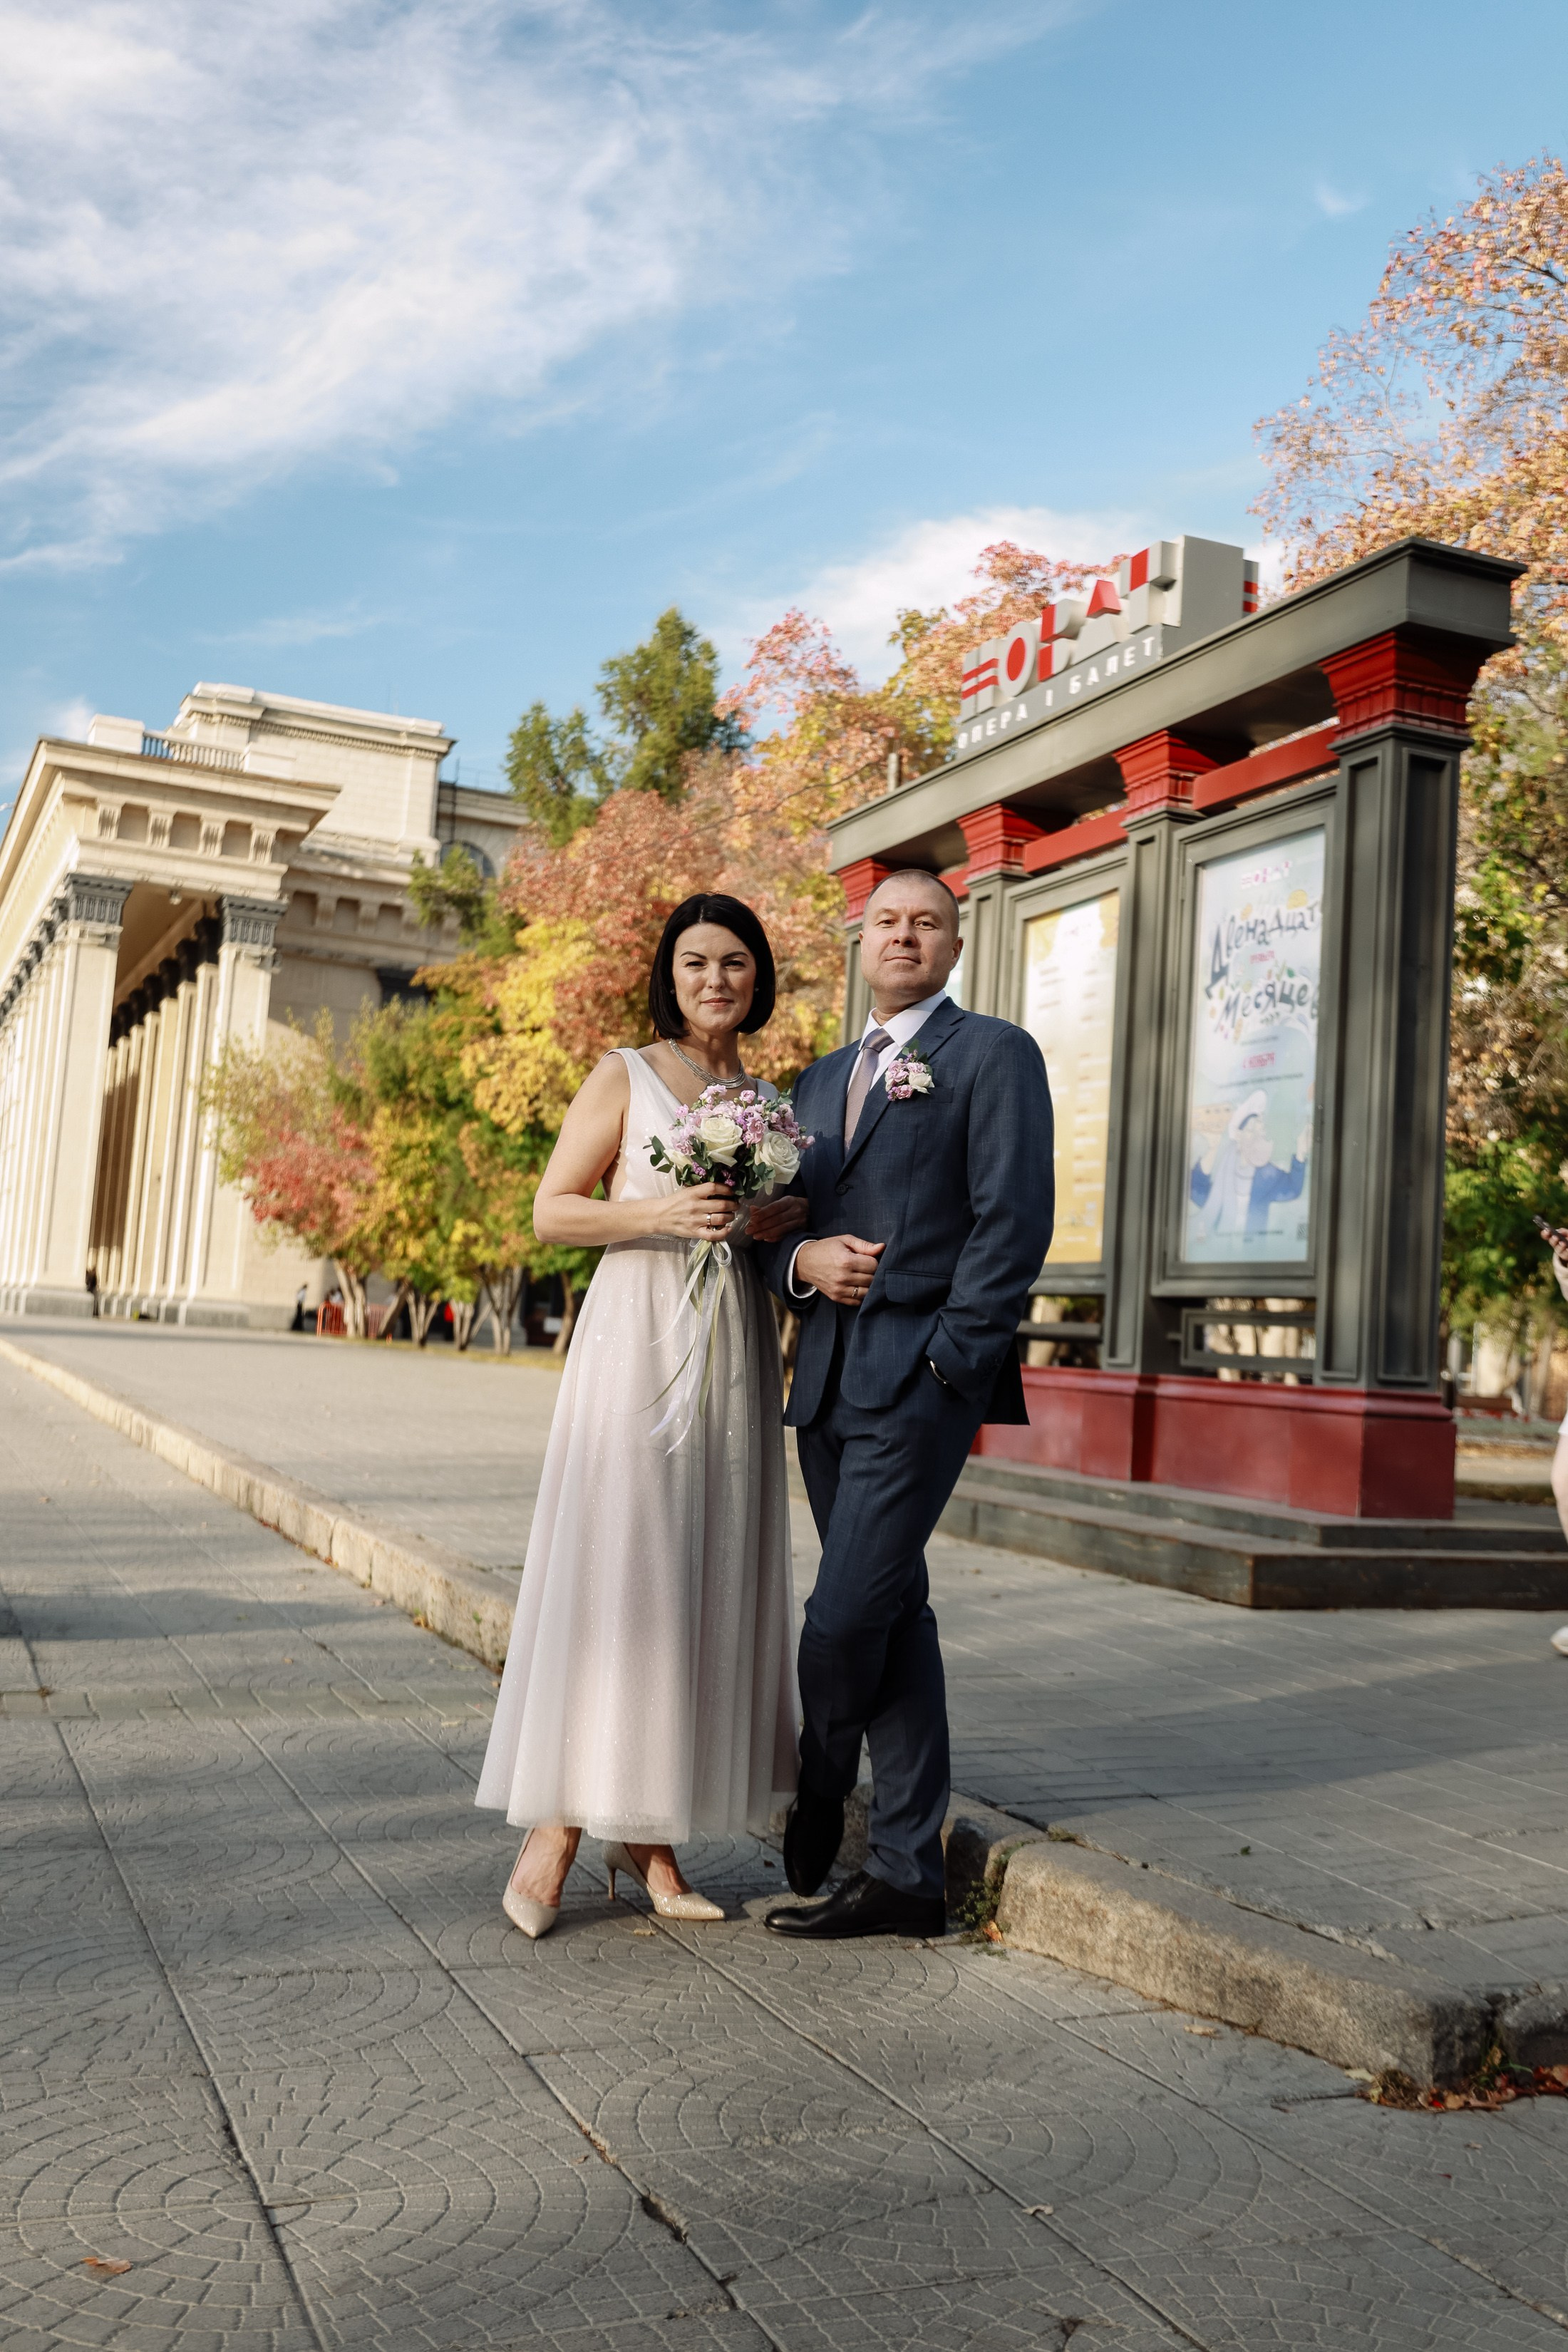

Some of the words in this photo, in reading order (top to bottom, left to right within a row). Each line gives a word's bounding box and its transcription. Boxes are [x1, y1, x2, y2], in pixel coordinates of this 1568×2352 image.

[958, 703, 1028, 749] ОПЕРА
[1069, 636, 1155, 695] БАЛЕТ
[1205, 899, 1321, 1000] Двенадцат
